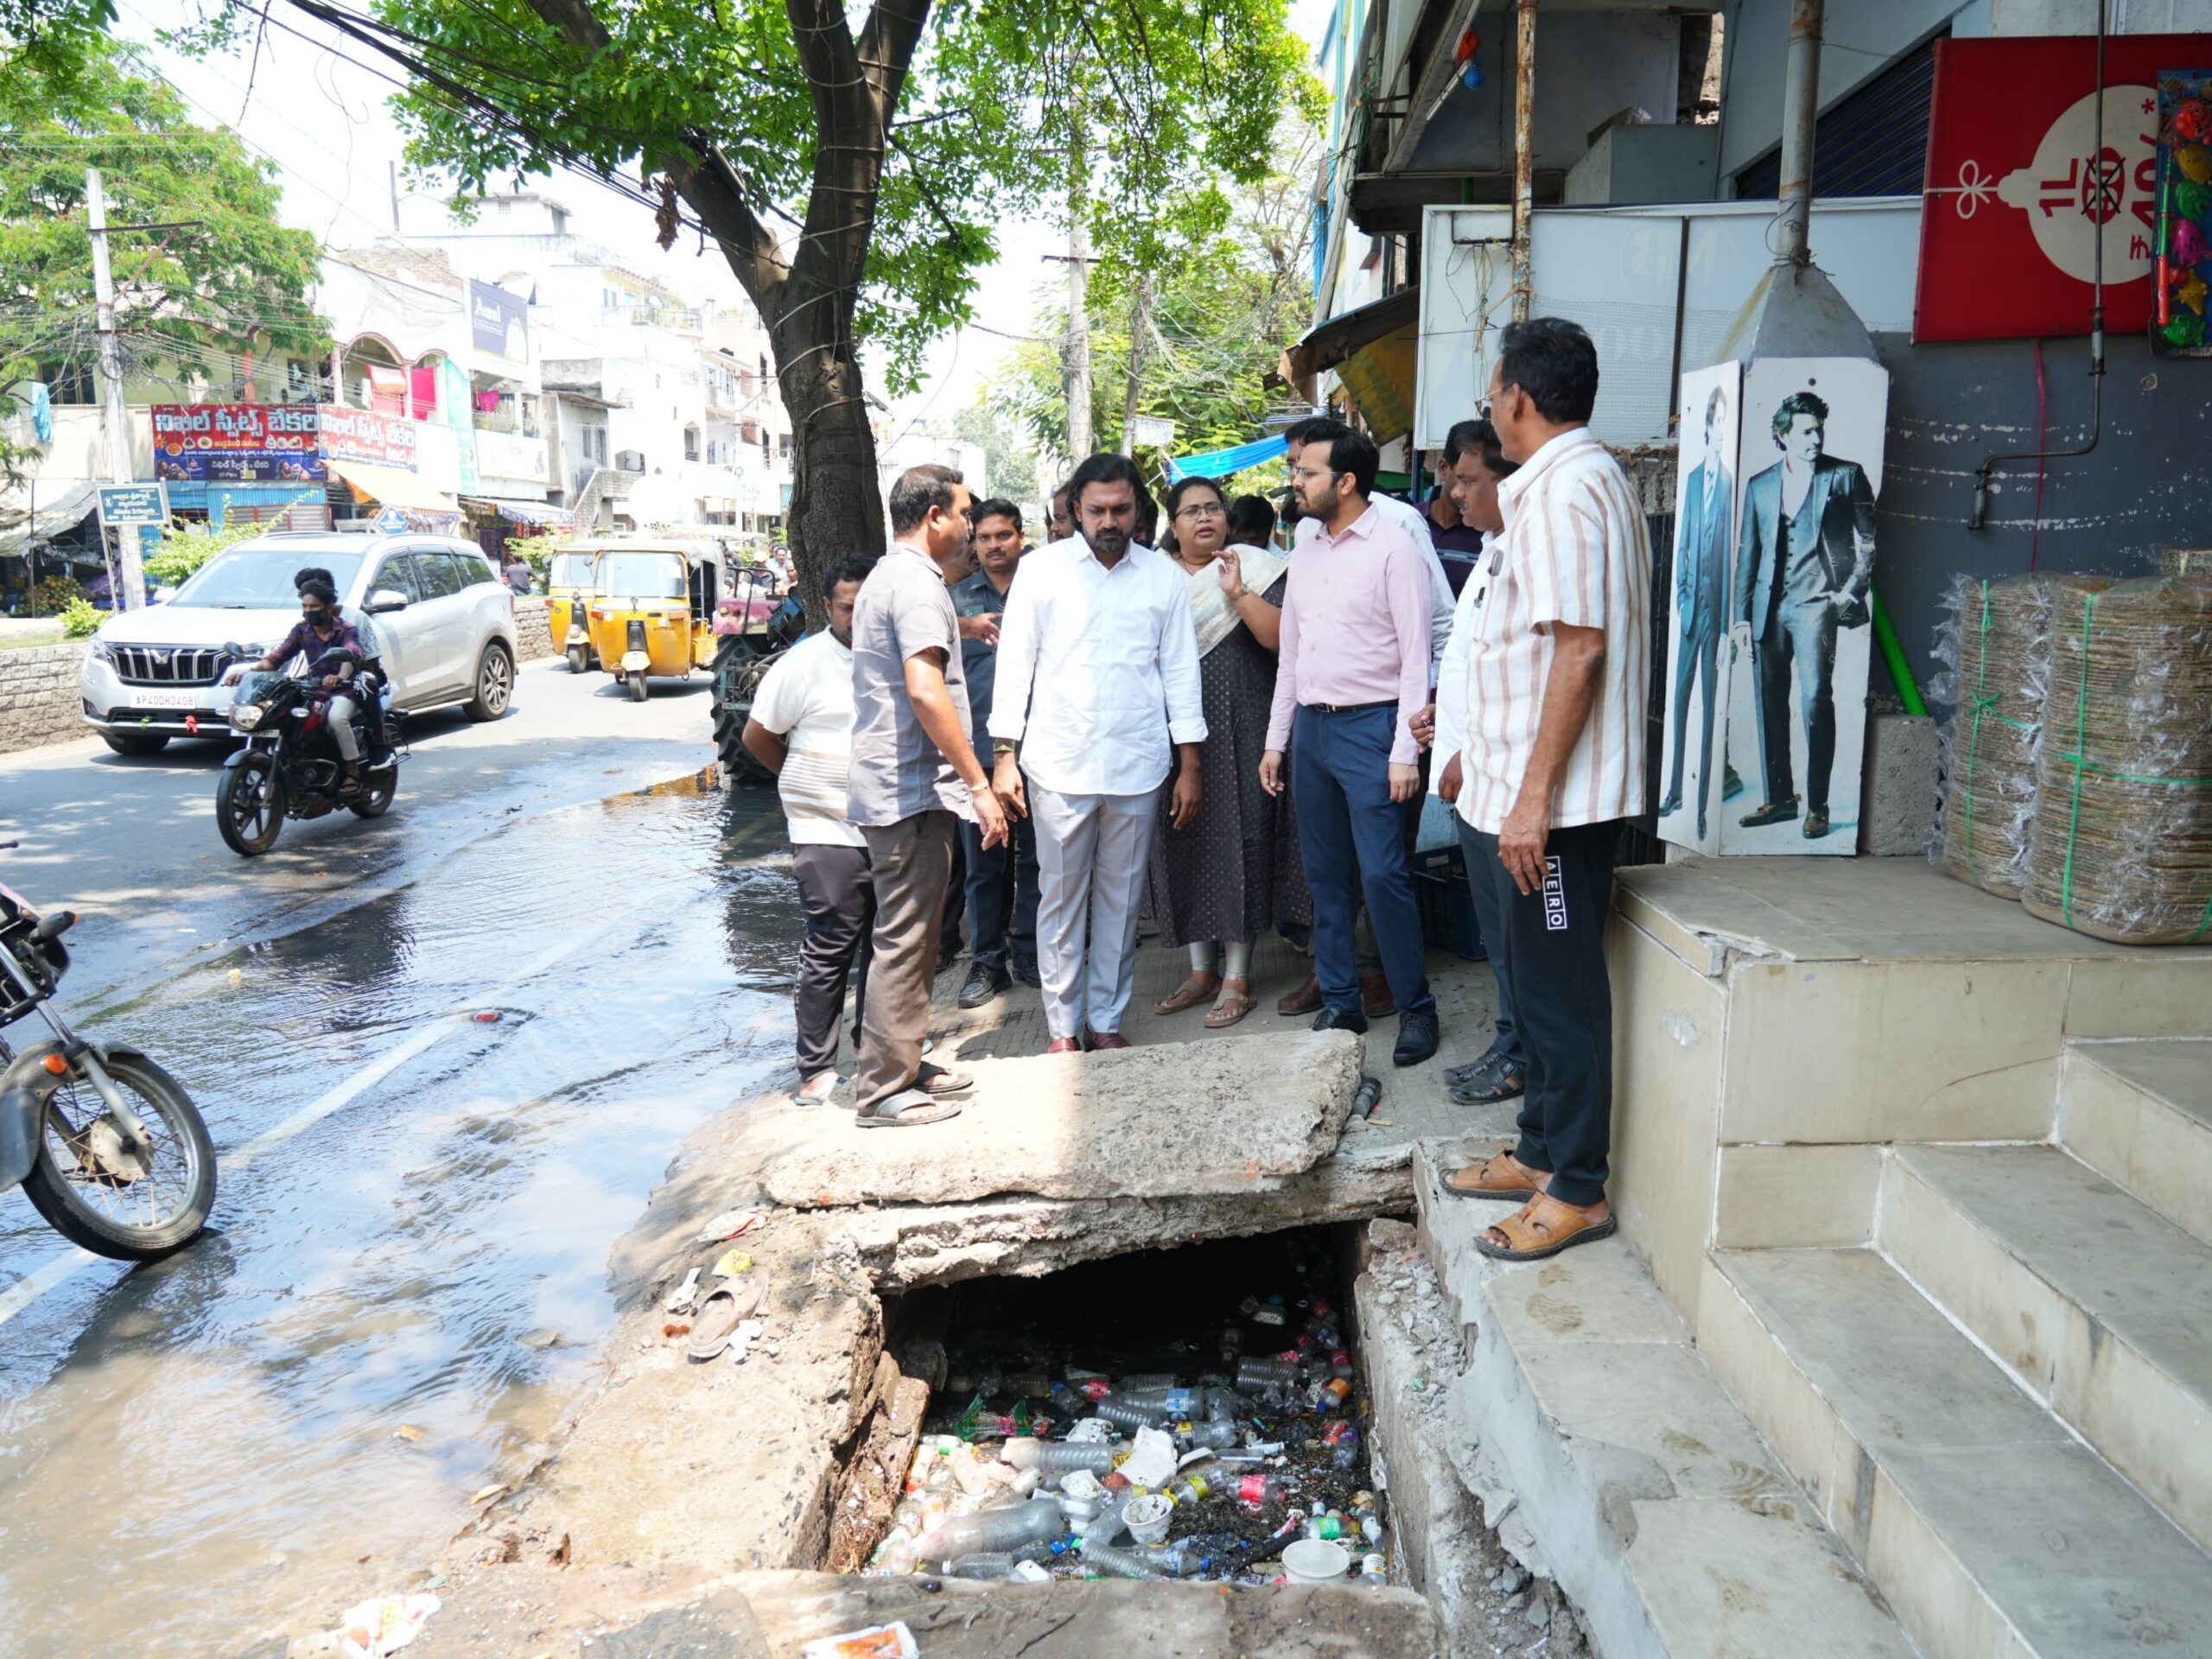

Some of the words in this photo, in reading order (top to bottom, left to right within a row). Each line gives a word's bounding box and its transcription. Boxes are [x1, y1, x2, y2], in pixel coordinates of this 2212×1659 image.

[156, 410, 211, 435] నిఖిల్
[215, 408, 264, 437] స్వీట్స్
[1546, 861, 1563, 925] AERO
